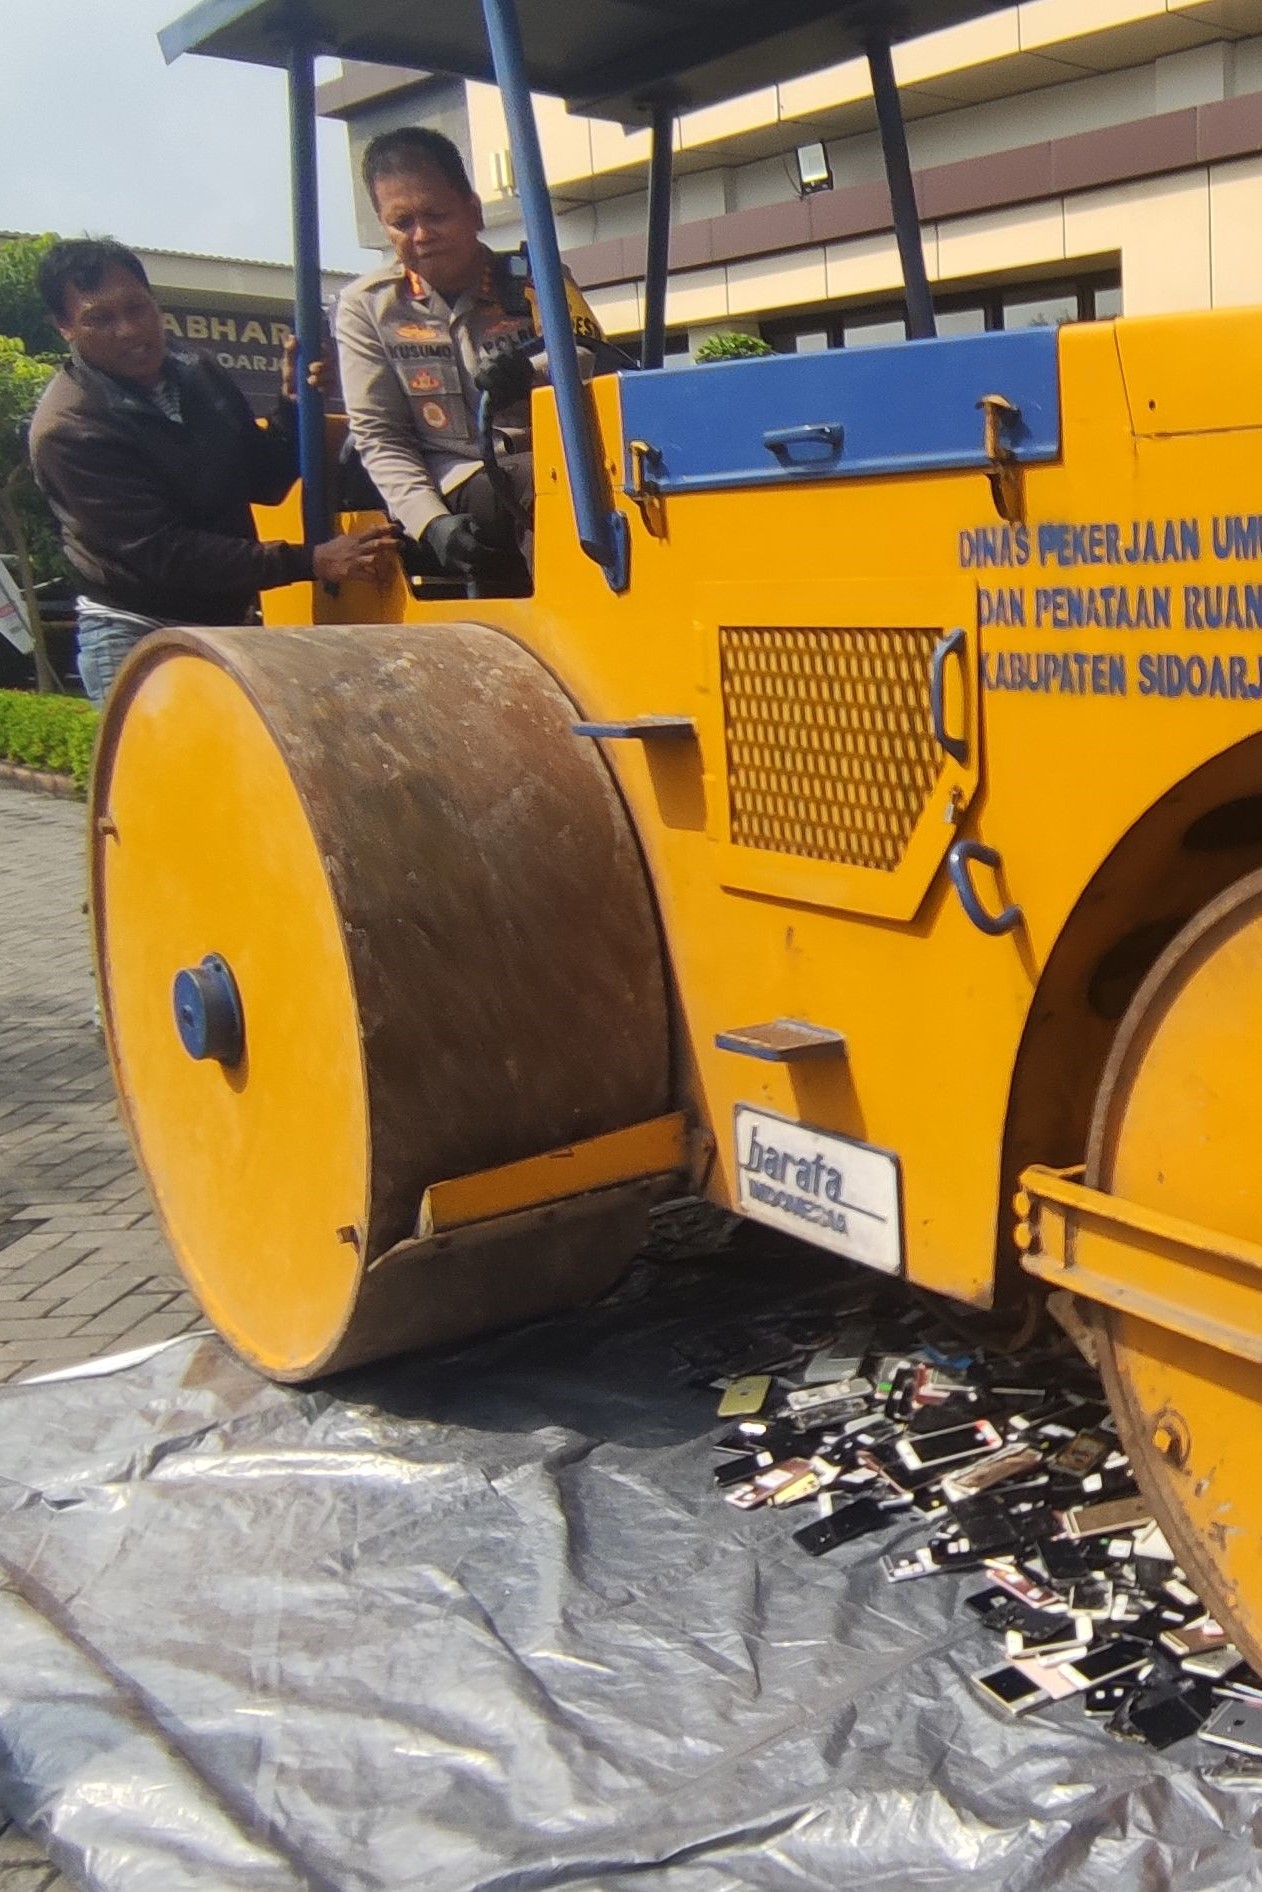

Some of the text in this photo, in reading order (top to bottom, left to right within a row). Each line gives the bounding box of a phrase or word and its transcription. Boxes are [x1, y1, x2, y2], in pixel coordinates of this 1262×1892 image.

[960, 522, 1030, 567] DINAS
[1037, 518, 1200, 567] PEKERJAAN
[979, 587, 1027, 627] DAN
[1036, 585, 1171, 628] PENATAAN
[746, 1125, 845, 1202] barata
